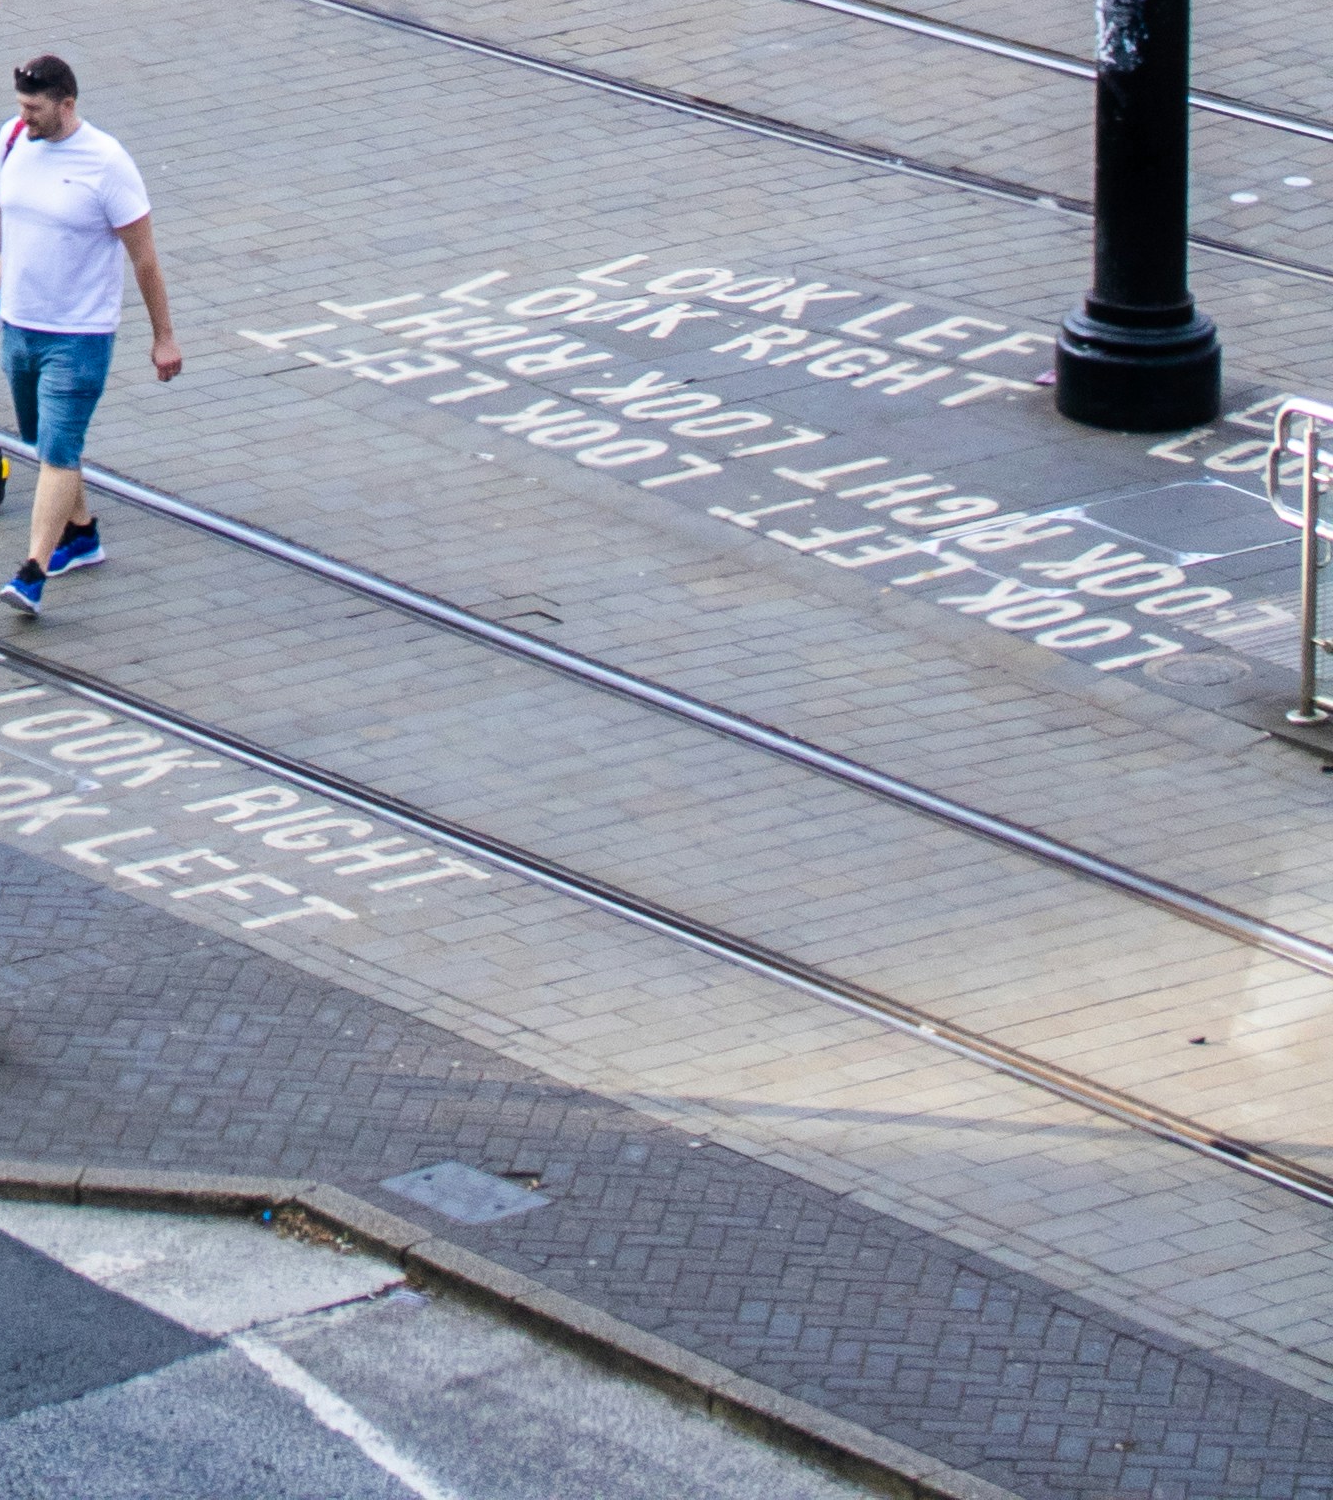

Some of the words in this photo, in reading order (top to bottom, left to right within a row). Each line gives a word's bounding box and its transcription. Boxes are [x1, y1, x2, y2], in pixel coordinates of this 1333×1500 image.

[440, 269, 721, 339] LOOK
[709, 322, 1041, 408] RIGHT
[576, 252, 863, 321] LOOK
[839, 301, 1057, 363] LEF
[61, 826, 360, 930] LEFT
[183, 784, 492, 894] RIGHT
